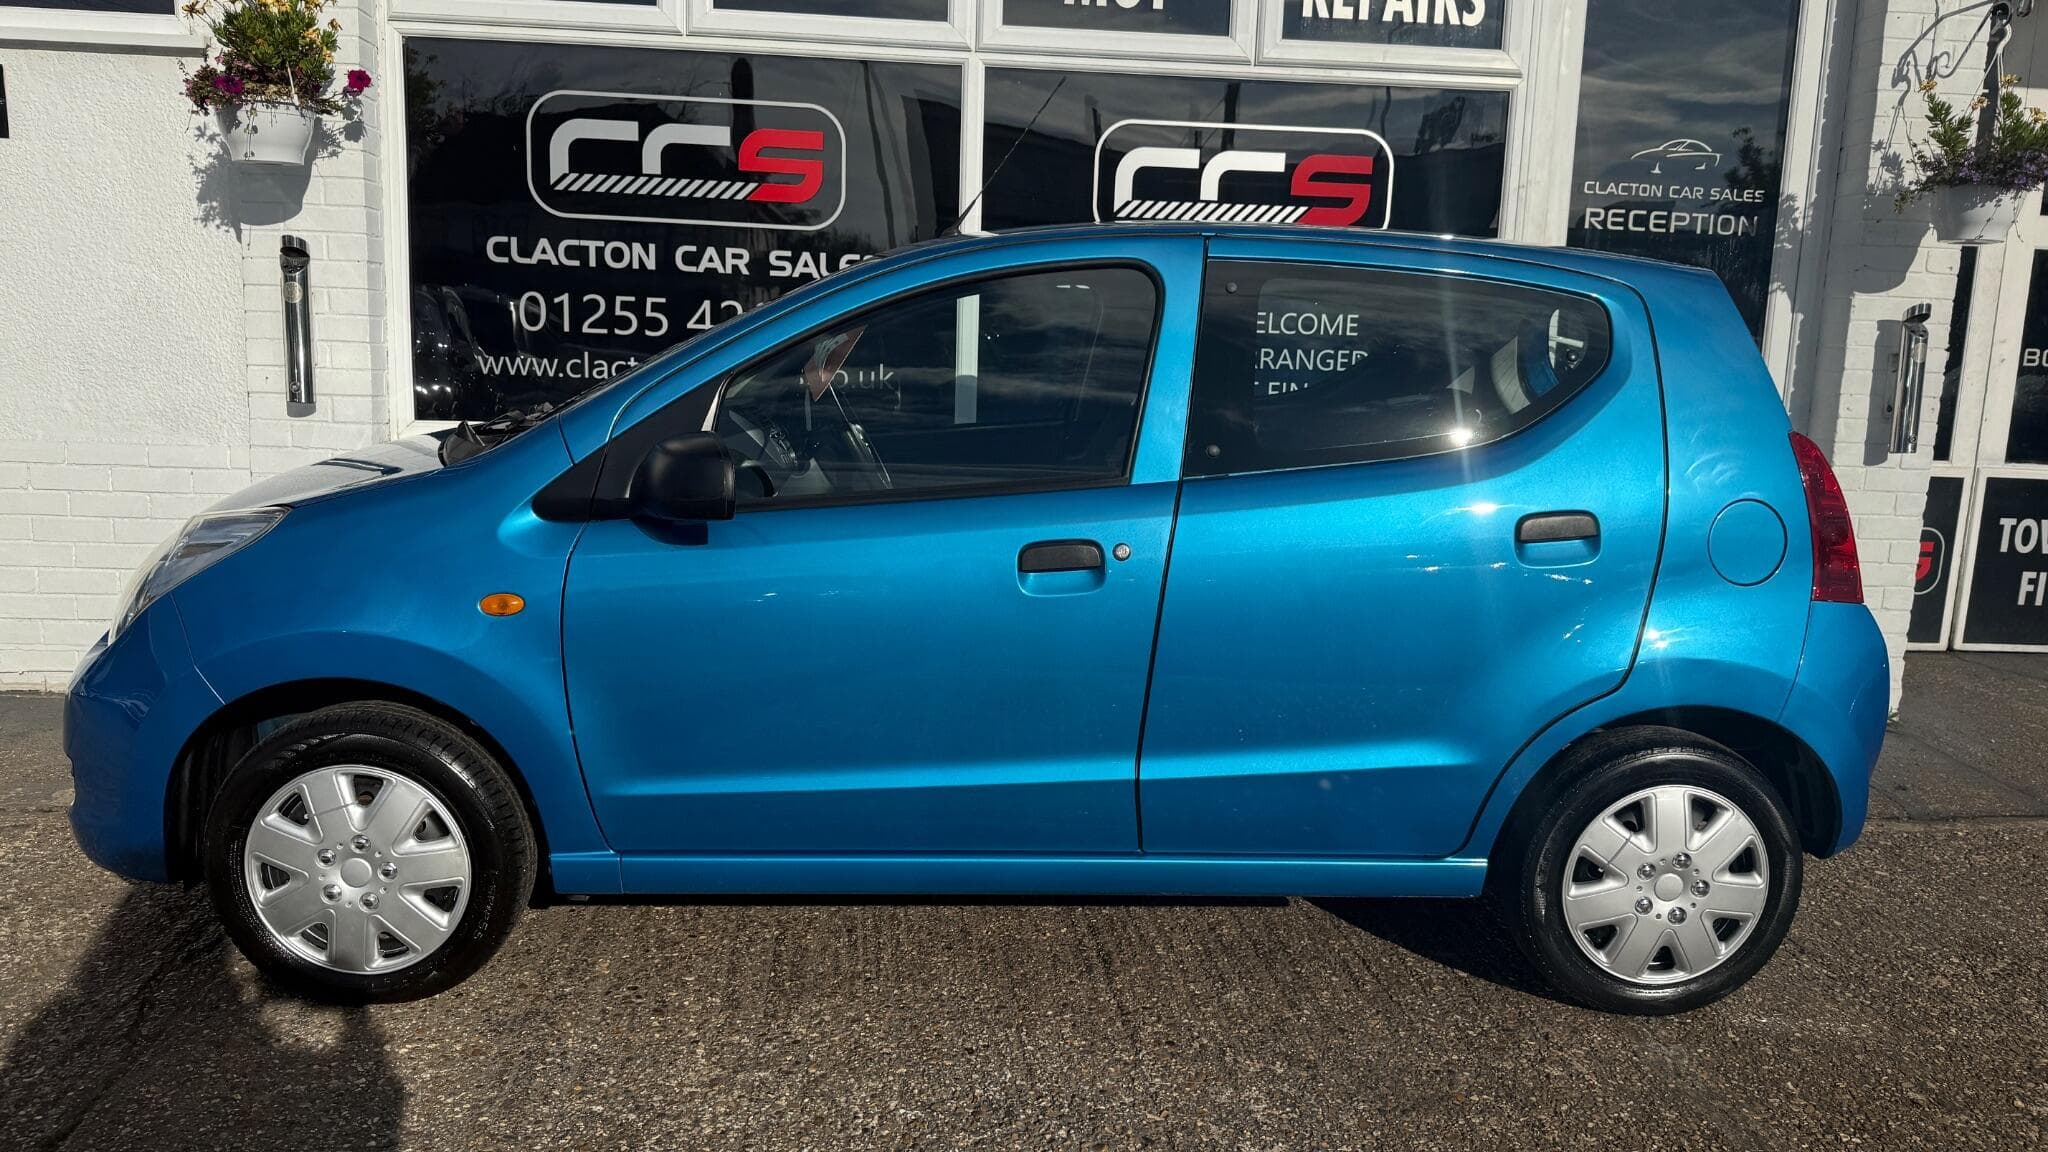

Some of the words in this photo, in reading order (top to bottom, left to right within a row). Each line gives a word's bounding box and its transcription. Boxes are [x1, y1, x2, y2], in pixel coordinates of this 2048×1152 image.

[1584, 181, 1662, 198] CLACTON
[1669, 185, 1704, 200] CAR
[1710, 188, 1765, 203] SALES
[1584, 207, 1758, 237] RECEPTION
[486, 236, 656, 270] CLACTON
[675, 245, 750, 275] CAR
[769, 250, 873, 280] SALE
[519, 291, 668, 337] 01255
